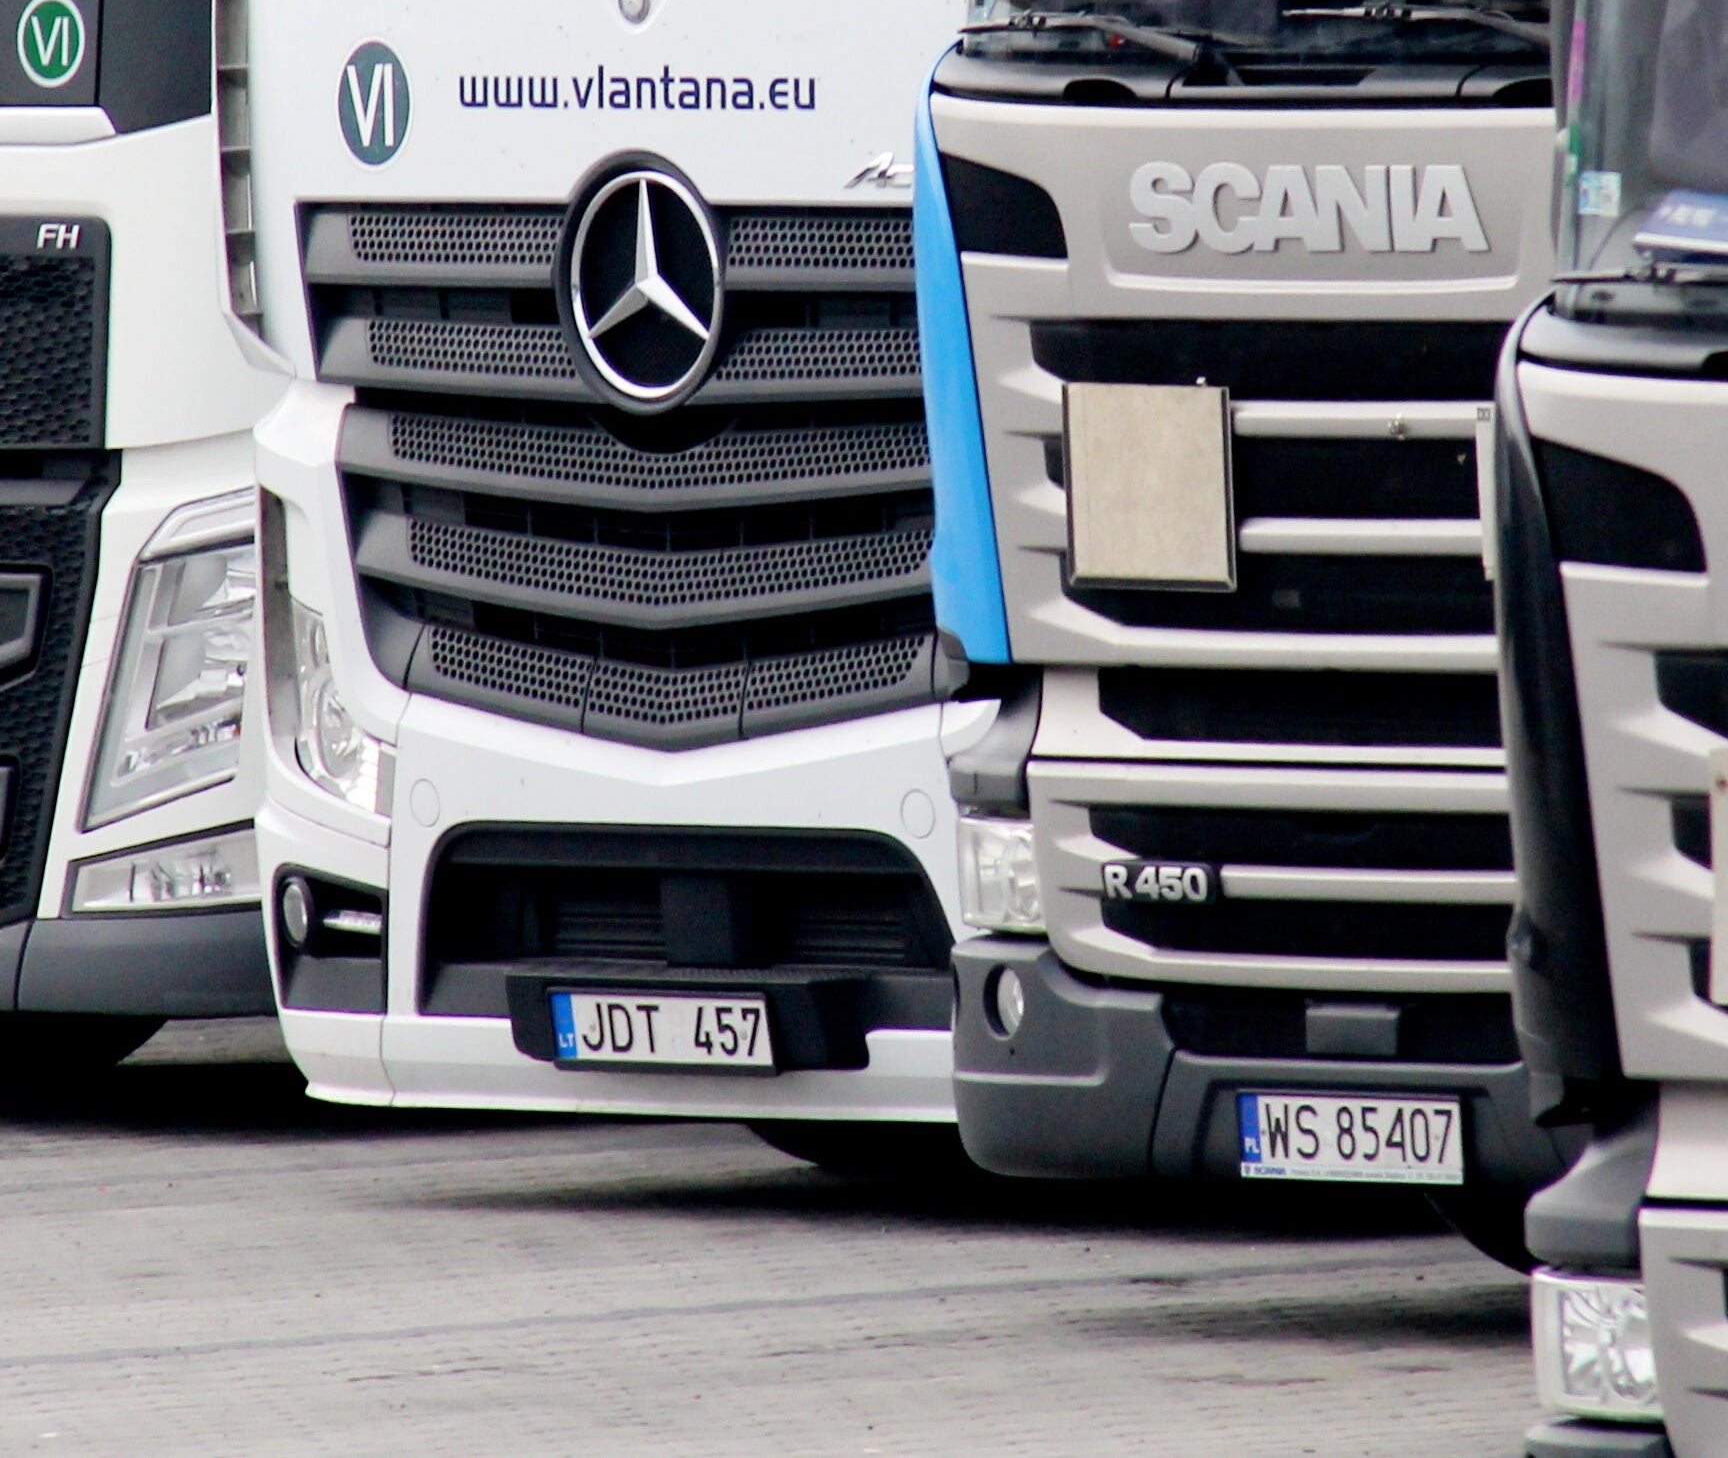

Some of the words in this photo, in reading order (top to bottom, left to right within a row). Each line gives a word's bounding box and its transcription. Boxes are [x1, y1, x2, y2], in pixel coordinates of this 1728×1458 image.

[346, 62, 394, 147] VI
[459, 64, 816, 111] www.vlantana.eu
[1129, 160, 1490, 255] SCANIA
[36, 224, 80, 250] FH
[1104, 864, 1133, 899] R
[1135, 865, 1208, 902] 450
[582, 1002, 660, 1054] JDT
[694, 1006, 761, 1057] 457
[1244, 1138, 1260, 1154] PL
[1265, 1103, 1320, 1160] WS
[1336, 1105, 1453, 1164] 85407
